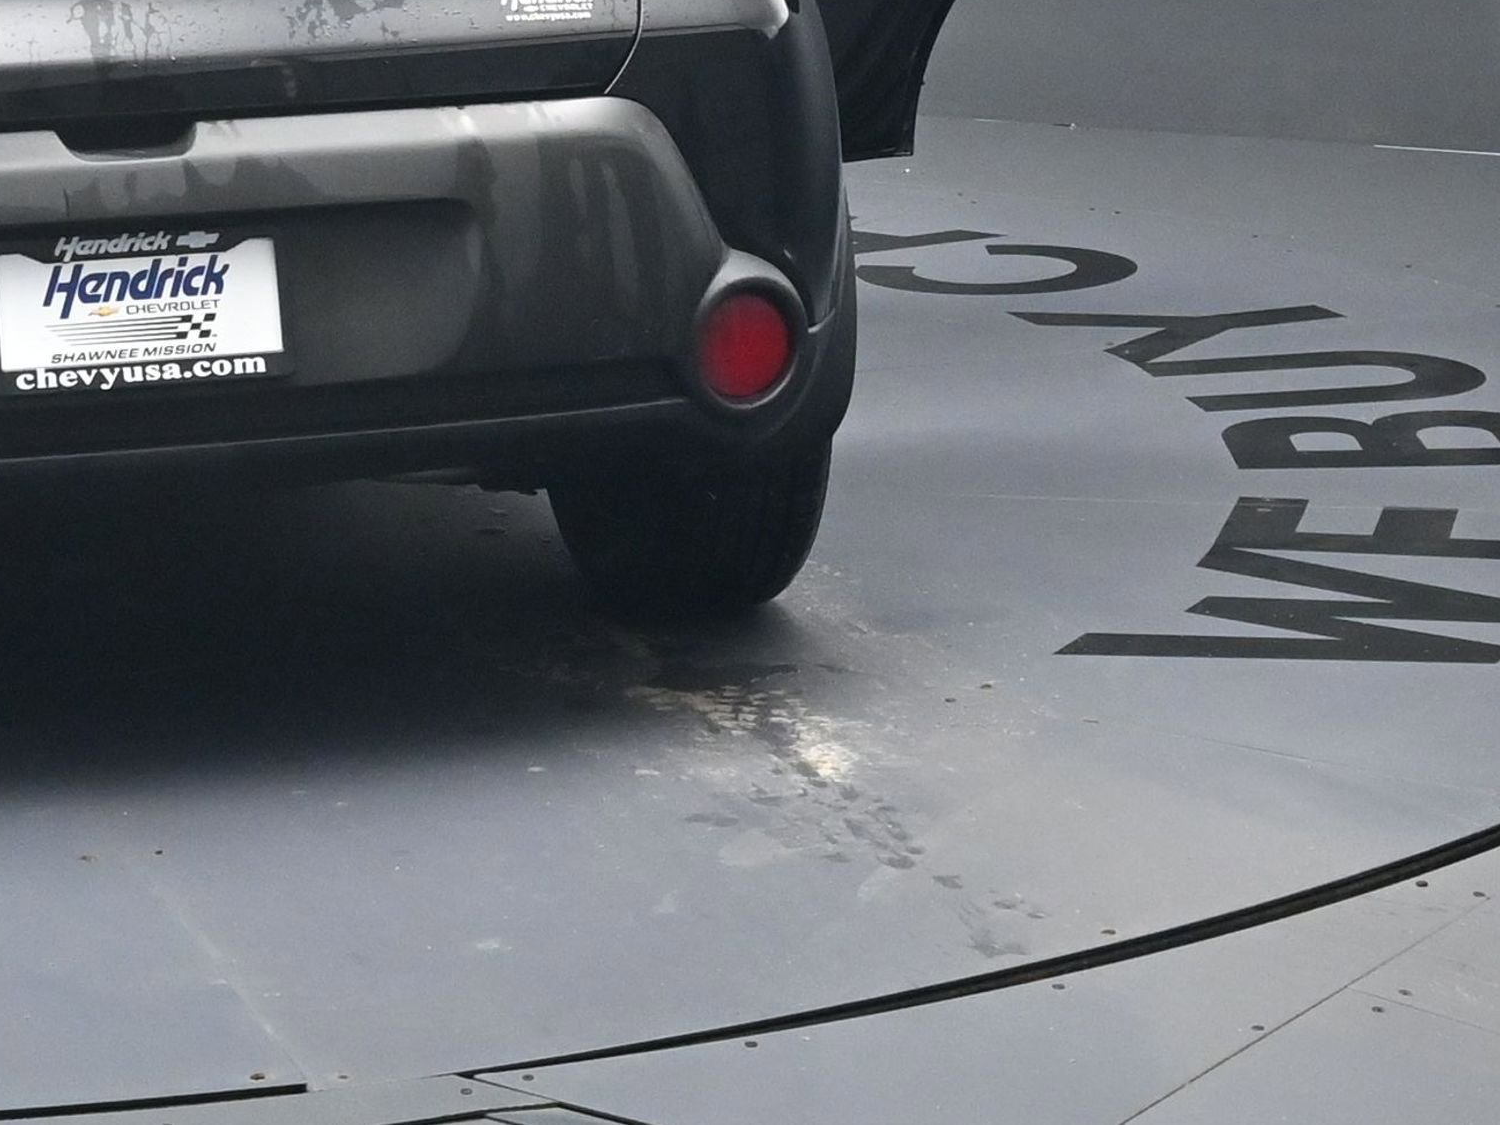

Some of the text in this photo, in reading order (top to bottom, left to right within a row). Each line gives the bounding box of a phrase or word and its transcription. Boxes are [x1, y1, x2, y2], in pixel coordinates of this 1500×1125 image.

[54, 231, 172, 262] Hendrick
[43, 254, 230, 319] Hendrick
[126, 299, 220, 315] CHEVROLET
[51, 342, 216, 364] SHAWNEE MISSION
[16, 356, 267, 390] chevyusa.com
